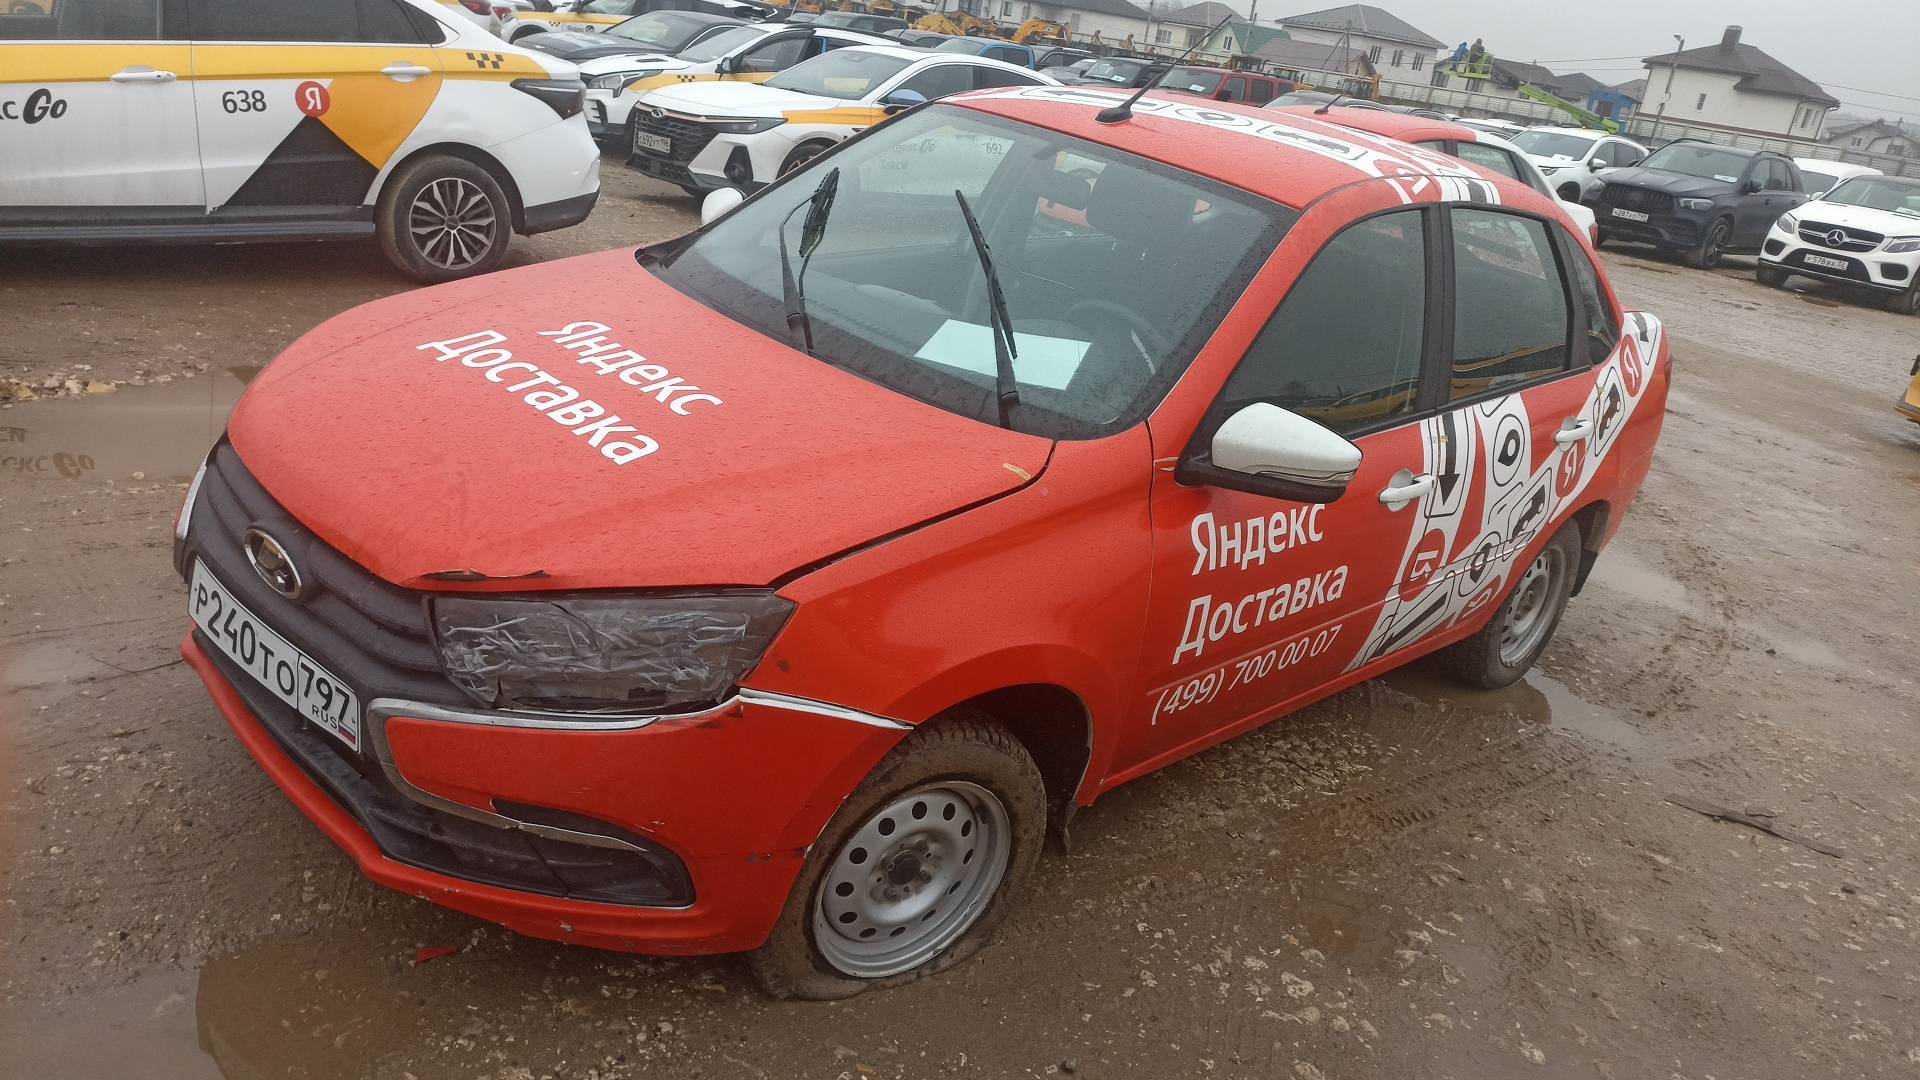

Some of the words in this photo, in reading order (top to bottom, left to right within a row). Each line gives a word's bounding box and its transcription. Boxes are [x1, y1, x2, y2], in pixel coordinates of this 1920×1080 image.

[23, 88, 68, 124] Go
[221, 89, 267, 114] 638
[304, 86, 322, 110] Я
[415, 329, 660, 466] Доставка
[536, 321, 724, 416] Яндекс
[1190, 503, 1326, 576] Яндекс
[195, 582, 295, 696] Р240ТО
[300, 661, 350, 722] 797
[1171, 565, 1349, 665] Доставка
[311, 703, 338, 730] RUS
[1151, 667, 1225, 726] (499)
[1228, 650, 1277, 691] 700
[1277, 637, 1310, 671] 00
[1310, 623, 1342, 657] 07
